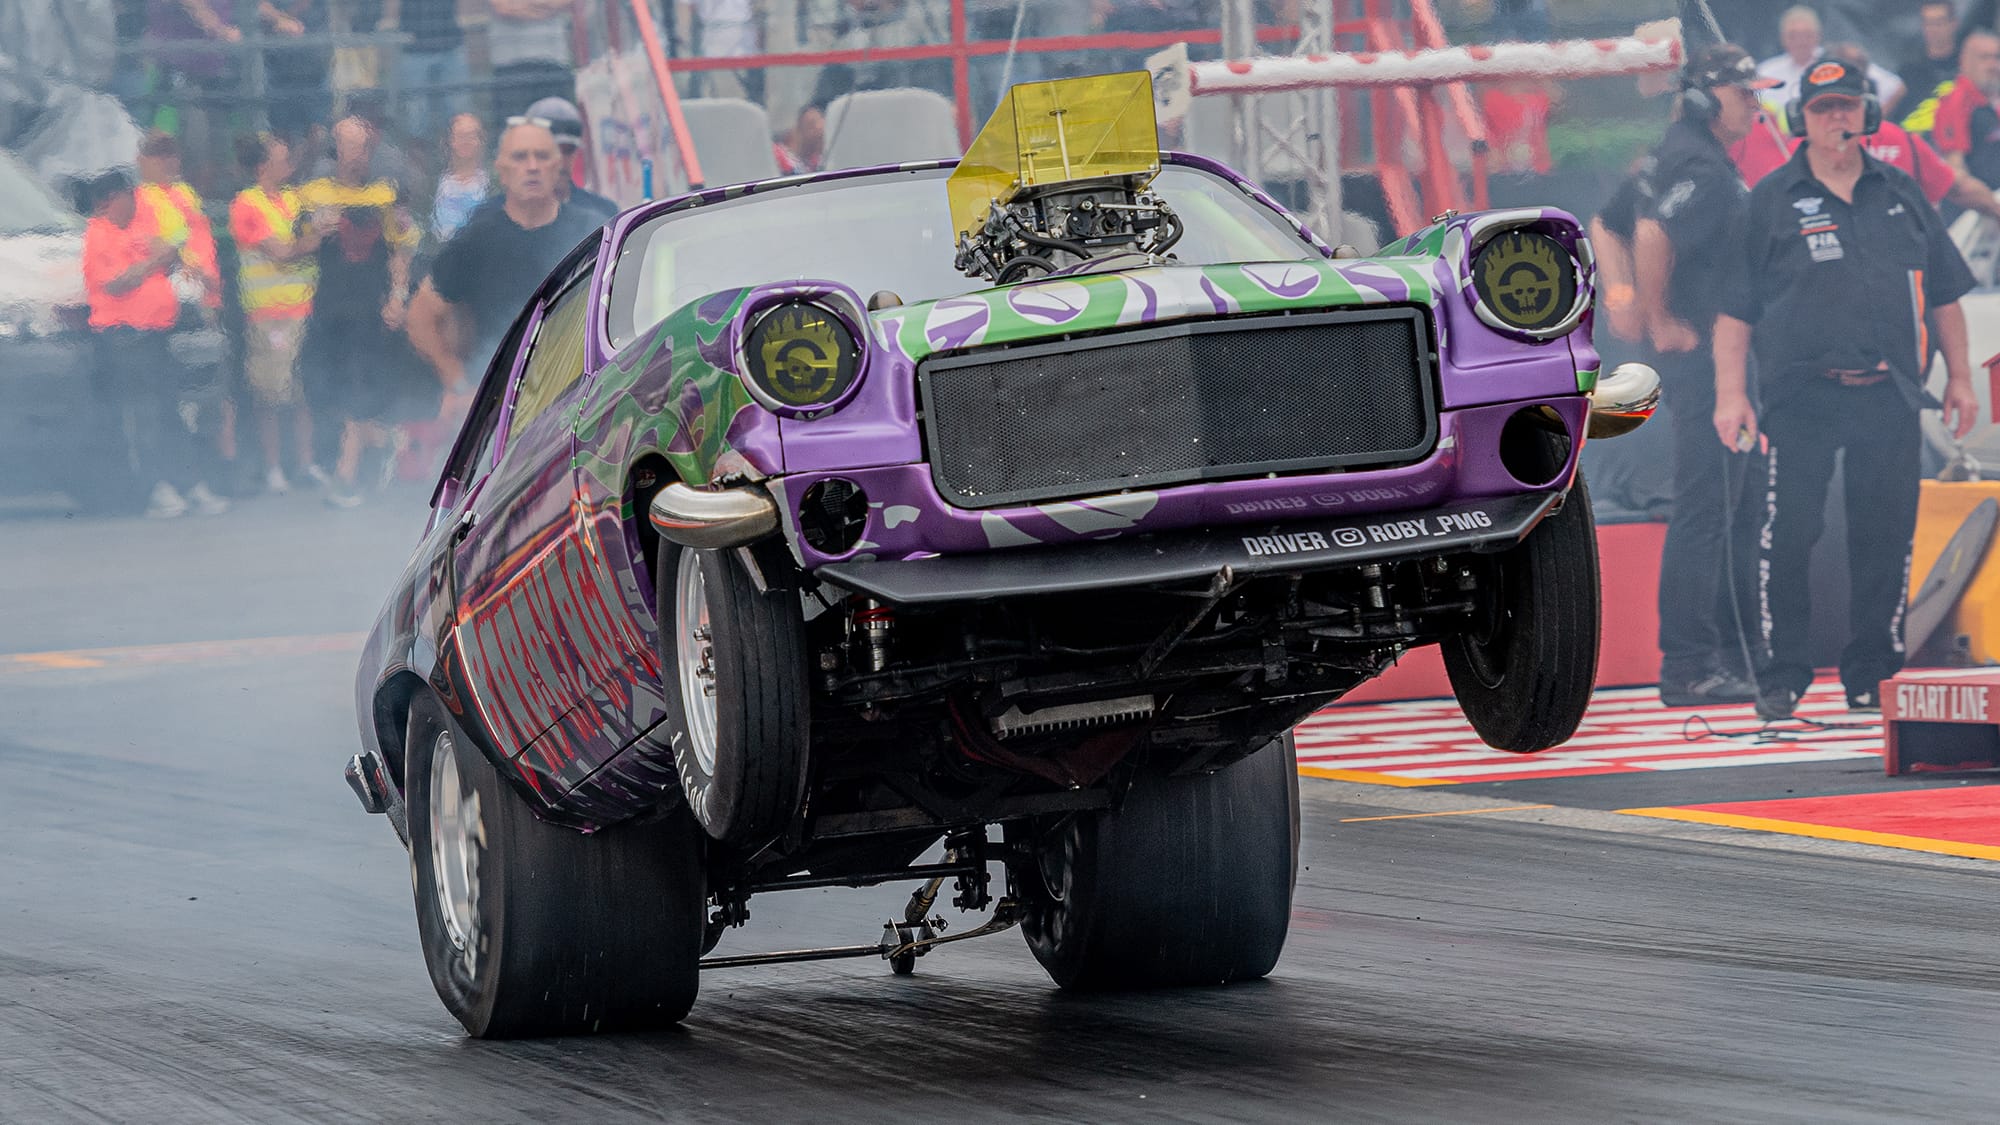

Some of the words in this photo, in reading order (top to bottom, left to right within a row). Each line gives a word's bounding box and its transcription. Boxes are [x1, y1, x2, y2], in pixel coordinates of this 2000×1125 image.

[1242, 532, 1328, 556] DRIVER
[1366, 511, 1492, 543] ROBY_PMG
[1897, 684, 1947, 718] START
[1951, 685, 1988, 720] LINE
